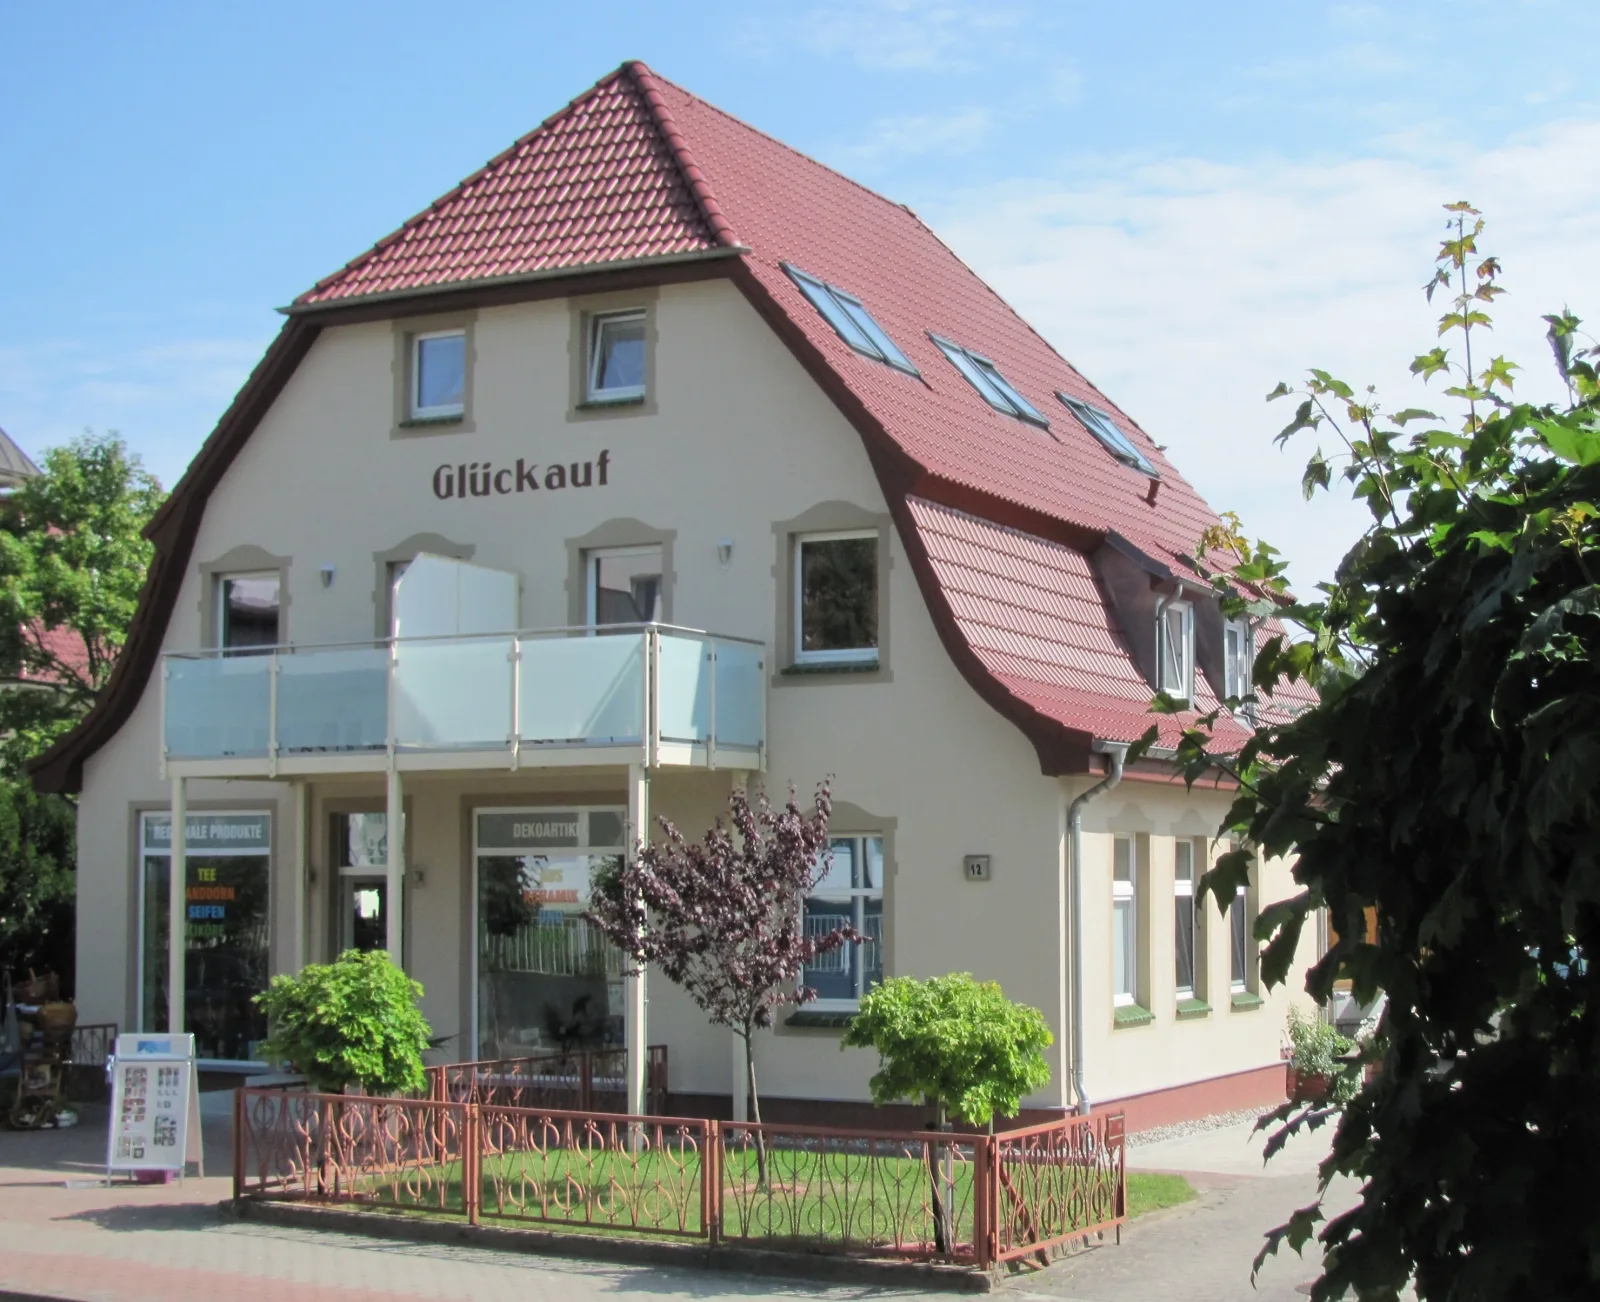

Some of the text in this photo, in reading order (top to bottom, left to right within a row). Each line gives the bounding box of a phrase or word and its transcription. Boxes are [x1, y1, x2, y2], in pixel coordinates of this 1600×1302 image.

[433, 449, 610, 500] Glückauf
[153, 824, 261, 840] REGNALE PRODUKTE
[198, 868, 217, 881] TEE
[970, 863, 983, 876] 12
[186, 886, 235, 900] ANDDORN
[188, 905, 225, 919] SEIFEN
